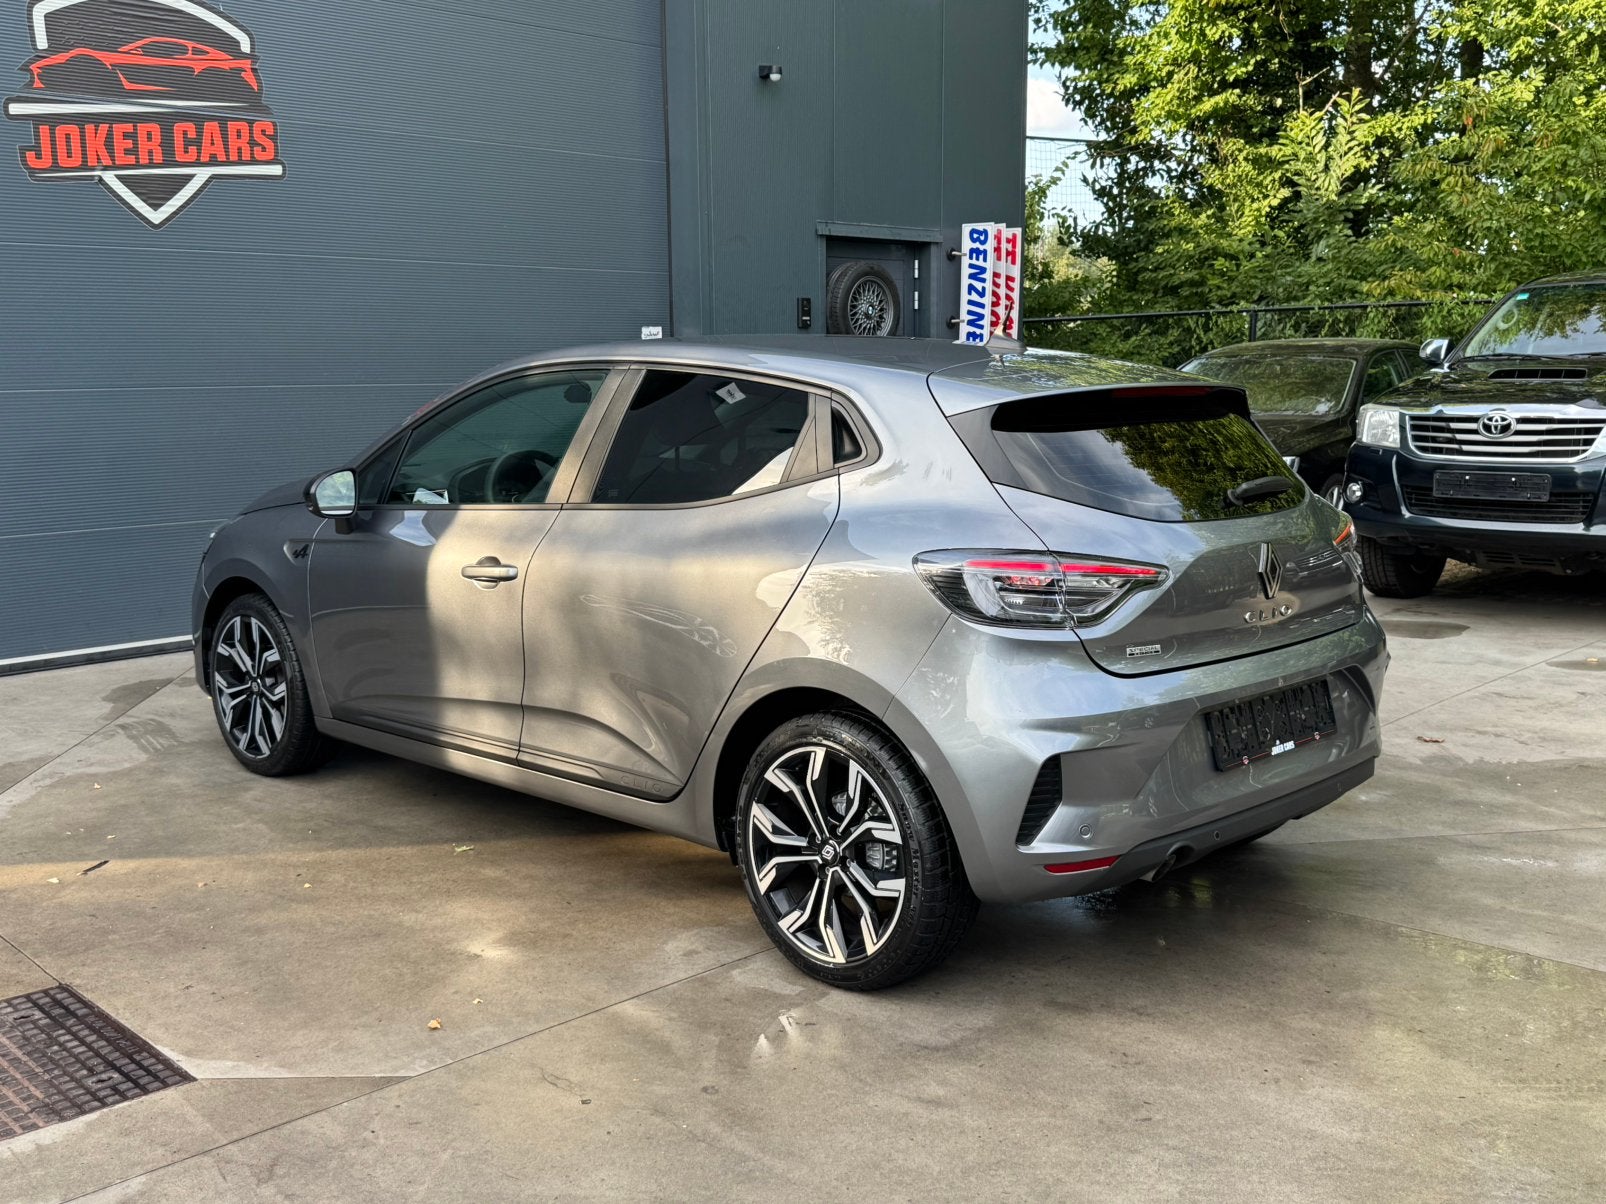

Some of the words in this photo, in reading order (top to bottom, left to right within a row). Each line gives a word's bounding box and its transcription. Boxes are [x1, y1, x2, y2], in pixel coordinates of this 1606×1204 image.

[26, 123, 163, 169] JOKER
[173, 121, 275, 162] CARS
[966, 227, 989, 343] BENZINE
[1243, 605, 1292, 623] CLIO
